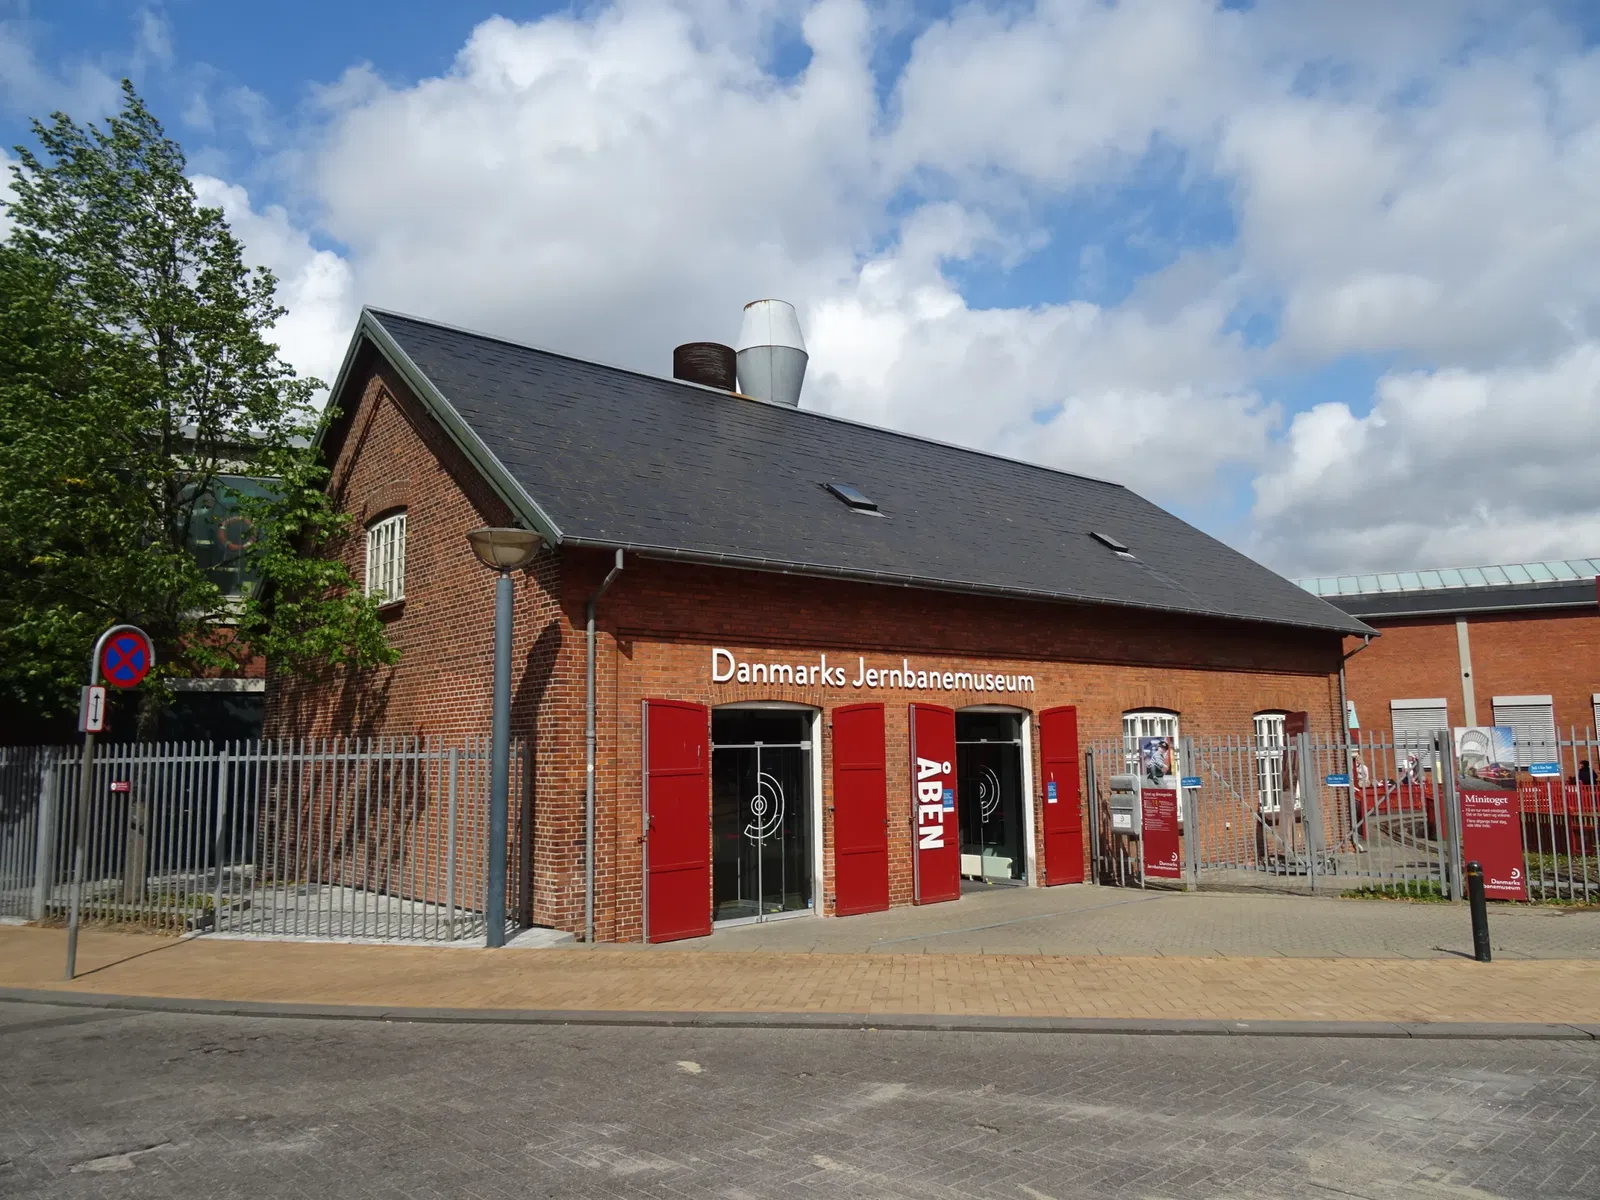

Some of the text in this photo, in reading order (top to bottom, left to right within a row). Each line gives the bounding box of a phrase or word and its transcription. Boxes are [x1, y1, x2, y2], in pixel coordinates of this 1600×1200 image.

[712, 648, 1035, 692] Danmarks Jernbanemuseum
[917, 757, 952, 850] ÅBEN
[1465, 794, 1509, 806] Minitoget
